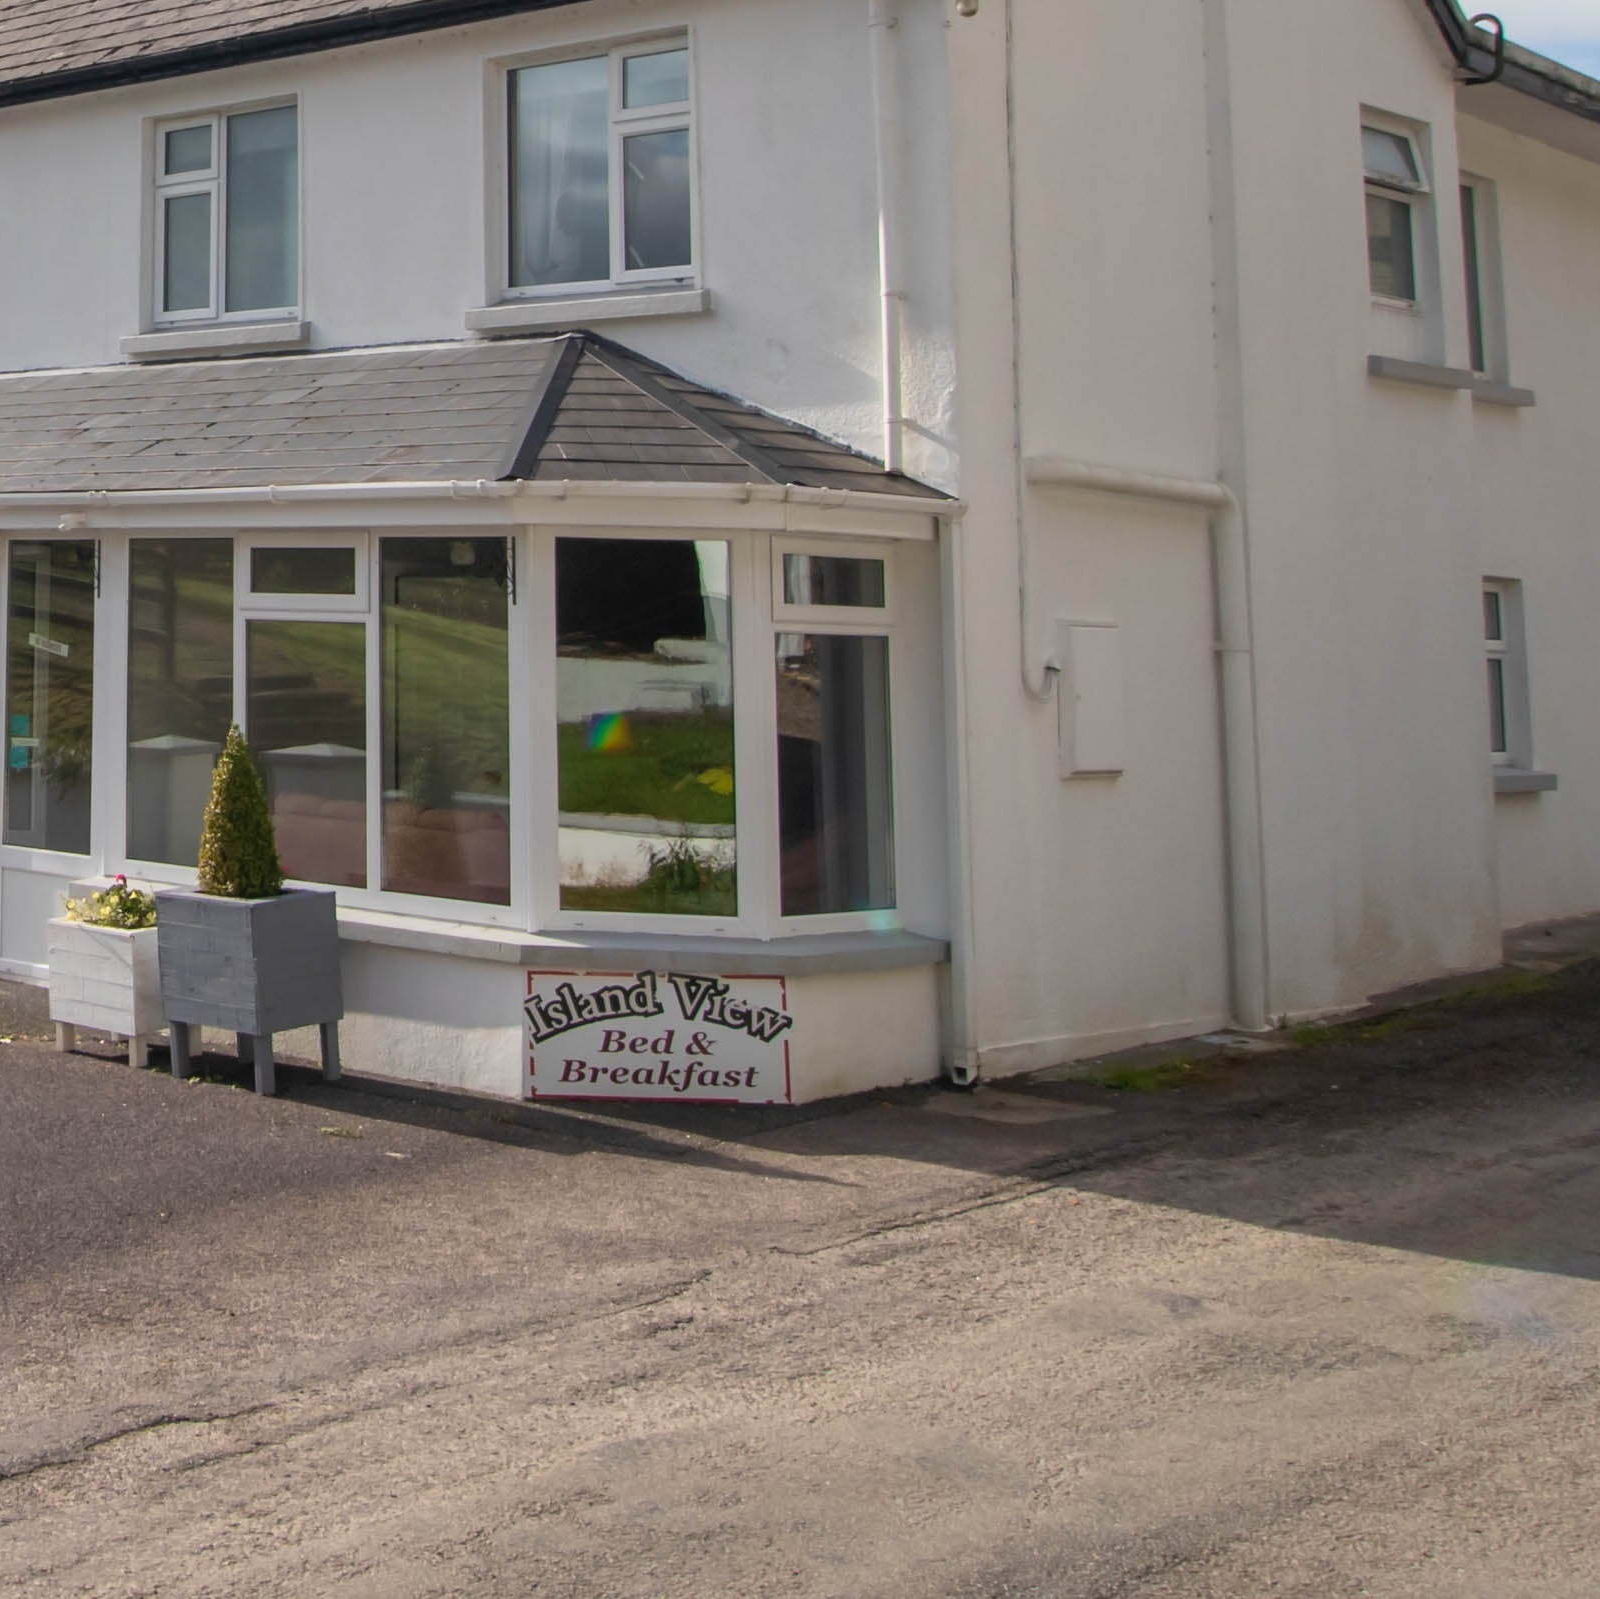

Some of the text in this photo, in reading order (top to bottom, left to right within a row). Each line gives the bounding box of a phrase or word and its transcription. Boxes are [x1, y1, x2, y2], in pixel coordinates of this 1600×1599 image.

[524, 970, 792, 1044] Island View
[598, 1029, 715, 1055] Bed &
[558, 1059, 759, 1092] Breakfast
